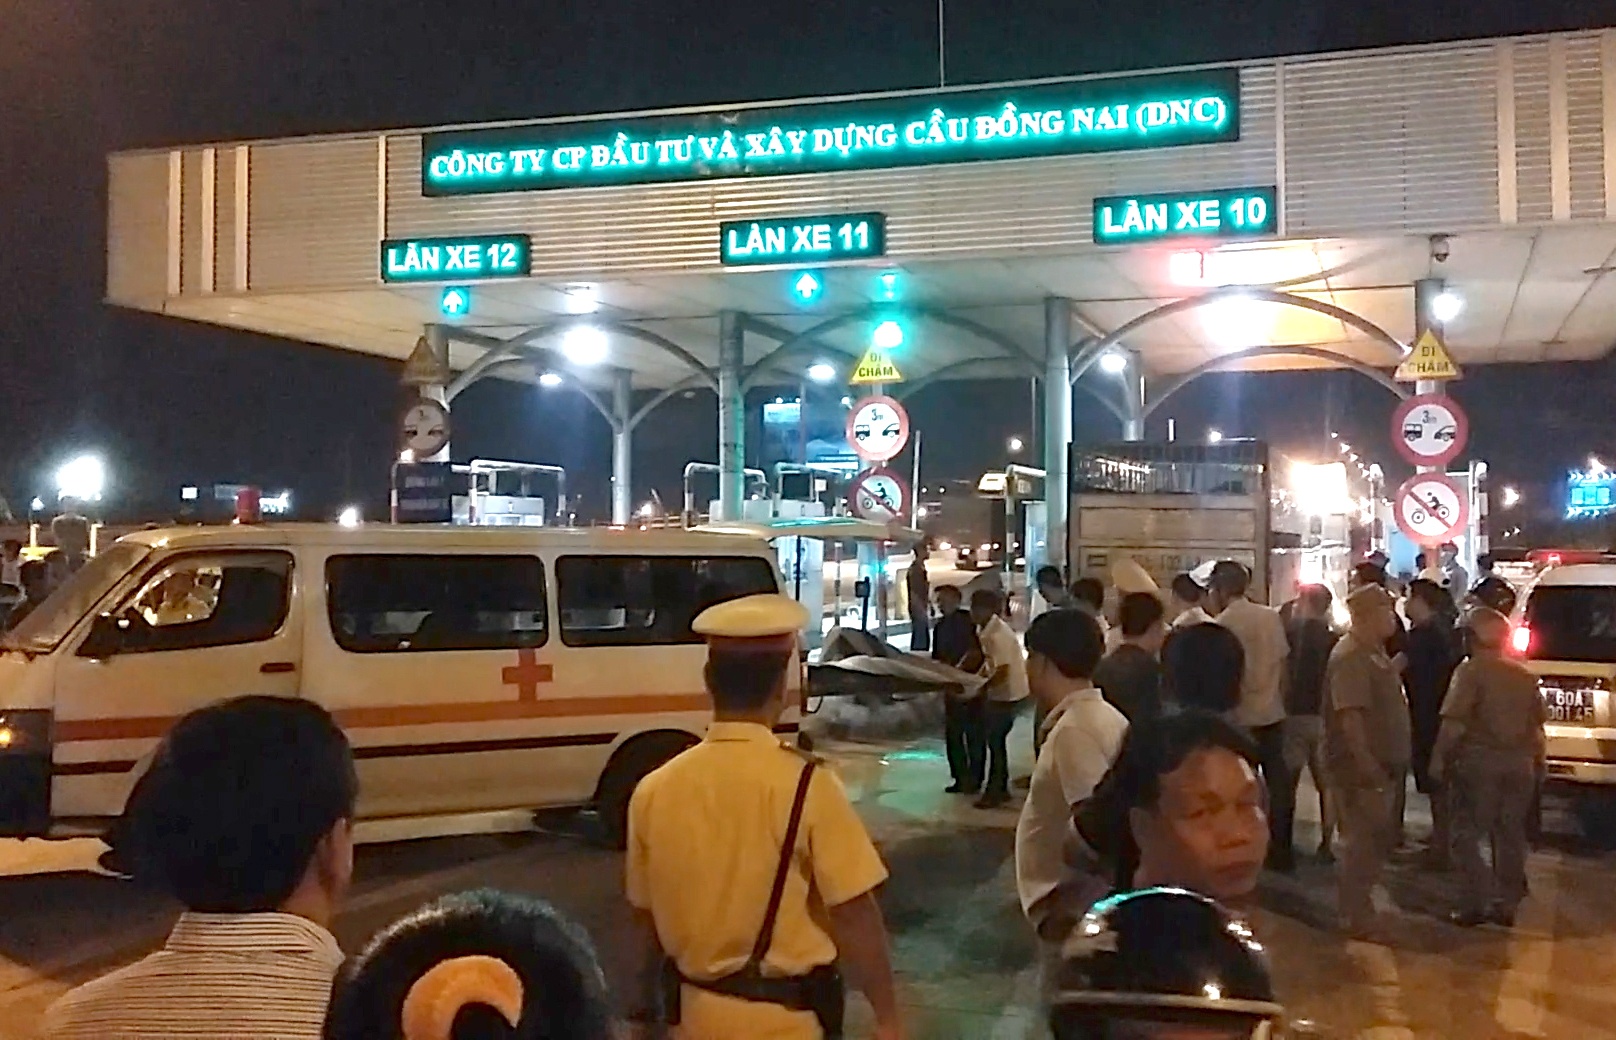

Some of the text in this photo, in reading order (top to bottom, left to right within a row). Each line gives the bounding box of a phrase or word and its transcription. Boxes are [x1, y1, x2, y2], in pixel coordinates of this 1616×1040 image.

[430, 96, 1227, 177] CÔNG TY CP ĐẦU TƯ VÀ XÂY DỰNG CẦU ĐỒNG NAI (DNC)
[1102, 197, 1267, 233] LÀN XE 10
[728, 221, 869, 255] LÀN XE 11
[387, 242, 517, 272] LÀN XE 12
[1556, 690, 1583, 706] 60A
